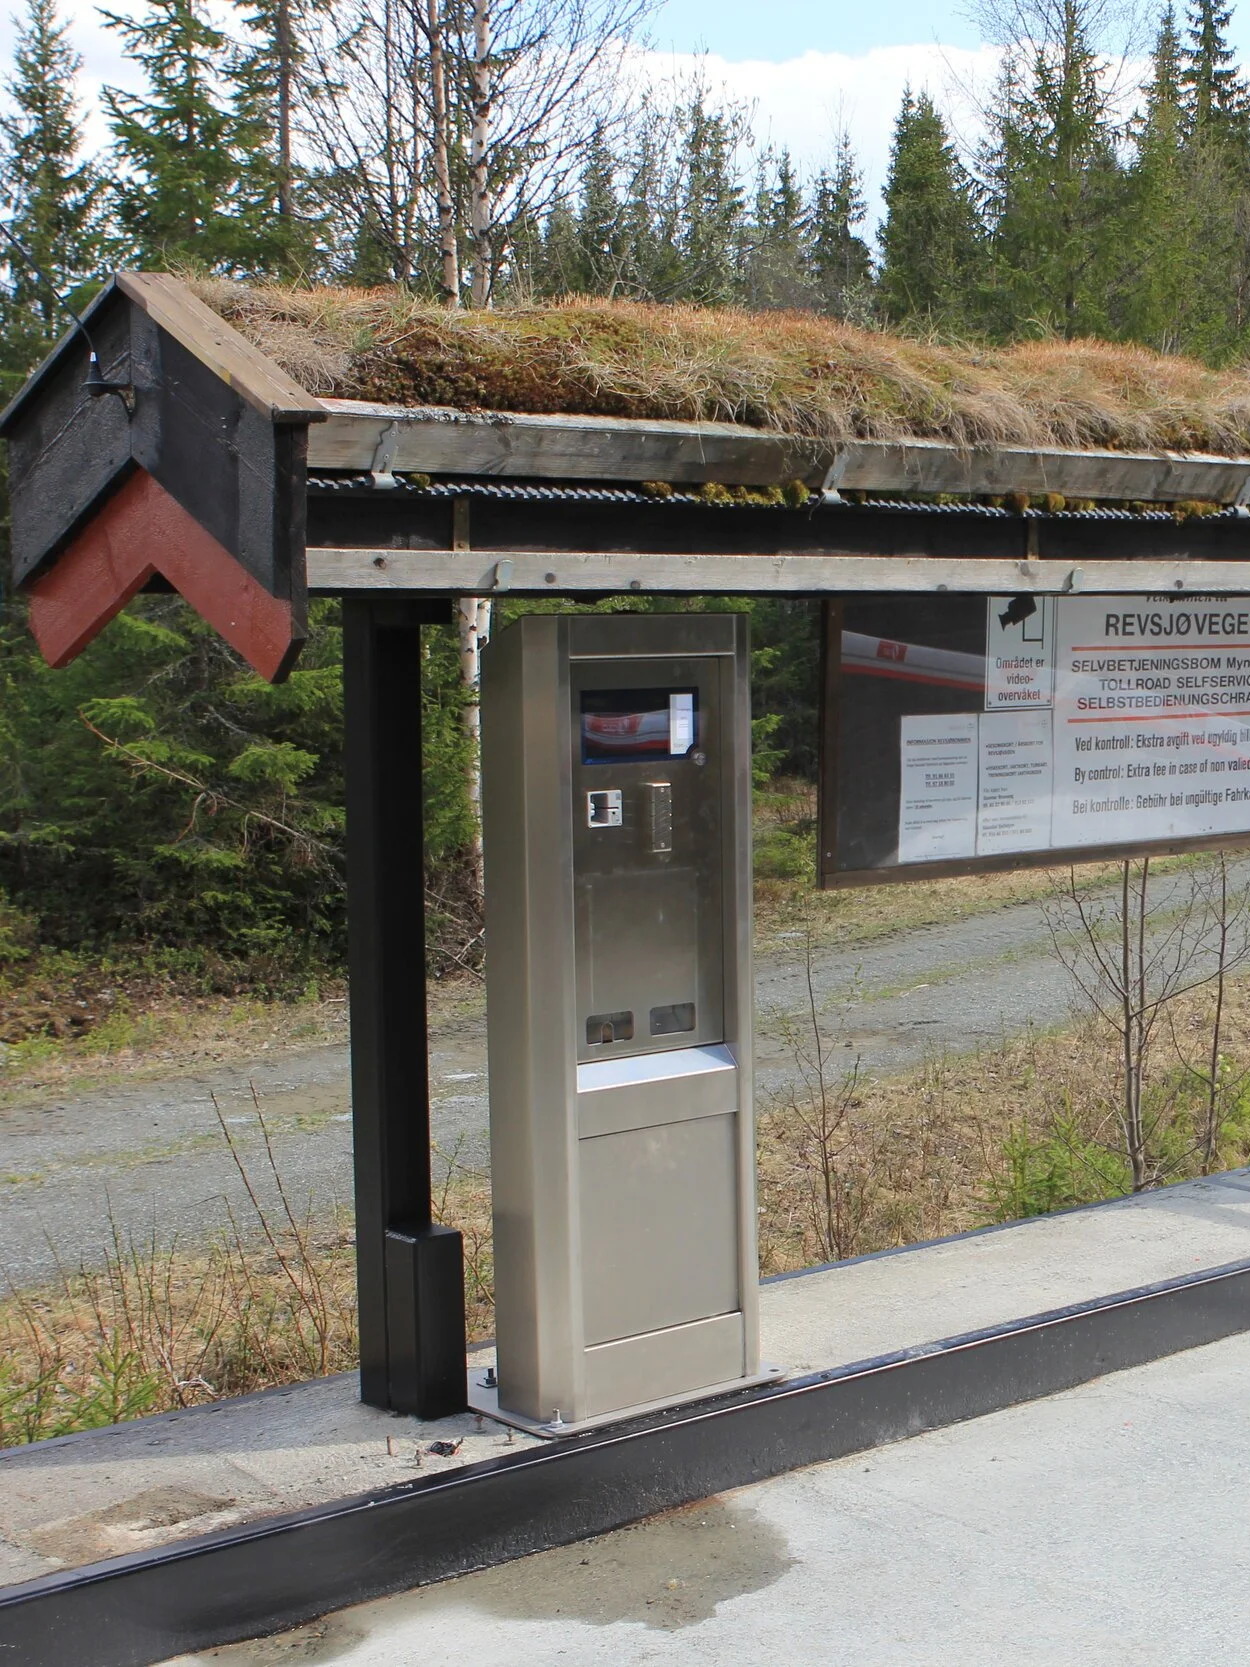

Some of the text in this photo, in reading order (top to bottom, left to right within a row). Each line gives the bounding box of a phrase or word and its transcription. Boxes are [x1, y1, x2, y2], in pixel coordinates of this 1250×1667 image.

[995, 656, 1045, 669] Området er
[1071, 657, 1221, 673] SELVBETJENINGSBOM
[1006, 673, 1034, 685] video-
[1098, 677, 1171, 692] TOLLROAD
[998, 688, 1041, 701] overvåket
[1075, 737, 1092, 752] Ved
[1094, 735, 1134, 750] kontroll:
[1136, 734, 1164, 749] Ekstra
[1166, 731, 1190, 750] avgift
[1191, 731, 1205, 745] ved
[1207, 729, 1237, 748] ugyldig
[1074, 767, 1086, 784] By
[1088, 765, 1124, 780] control:
[1127, 763, 1151, 778] Extra
[1152, 762, 1167, 777] fee
[1168, 762, 1177, 775] in
[1179, 762, 1198, 775] case
[1200, 759, 1208, 773] of
[1210, 760, 1225, 773] non
[1227, 757, 1250, 771] valied
[1072, 799, 1088, 815] Bei
[1089, 797, 1134, 813] kontrolle:
[1136, 793, 1167, 810] Gebühr
[1169, 792, 1183, 807] bei
[1185, 789, 1223, 808] ungültige
